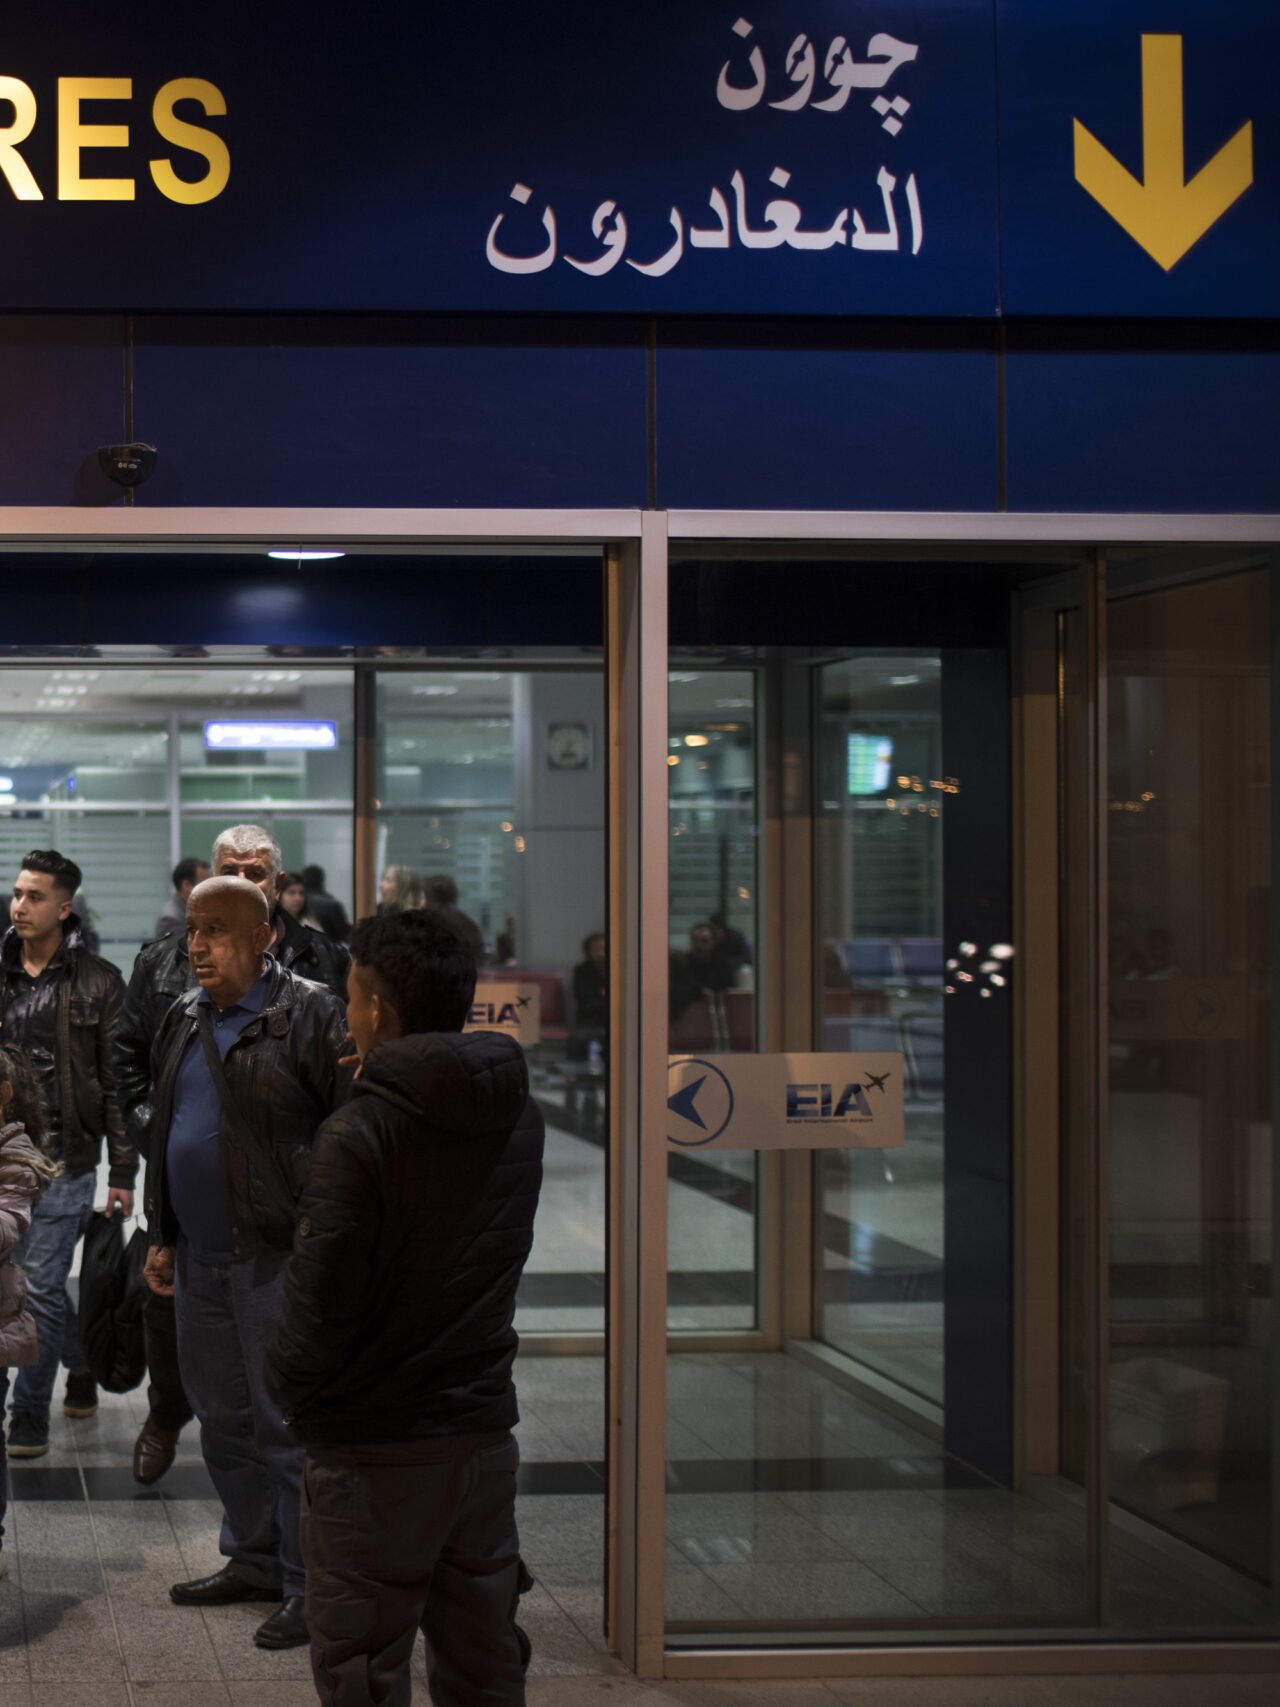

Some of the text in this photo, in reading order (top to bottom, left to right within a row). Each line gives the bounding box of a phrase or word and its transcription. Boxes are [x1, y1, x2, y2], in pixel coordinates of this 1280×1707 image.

[717, 18, 918, 136] چوون
[486, 166, 923, 277] المغادرون
[467, 1003, 520, 1024] EIA
[786, 1083, 873, 1117] EIA
